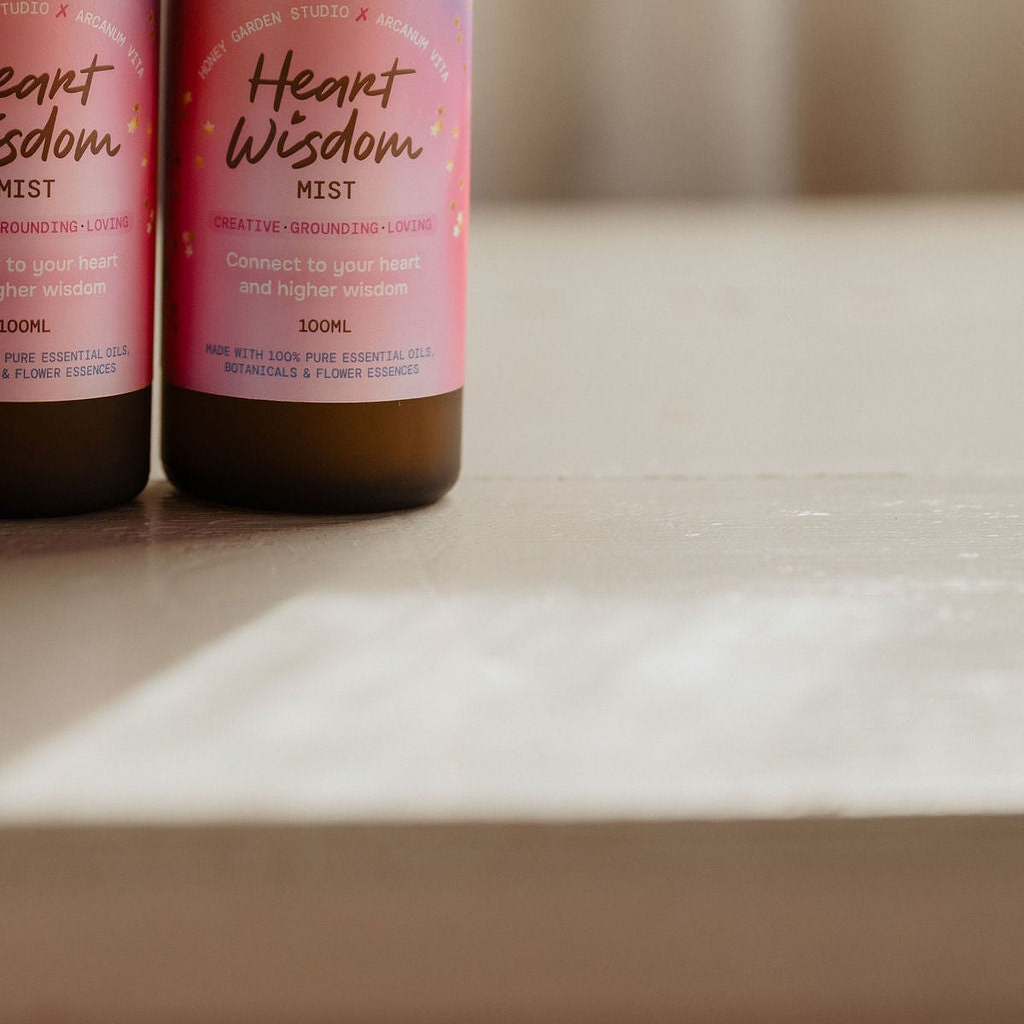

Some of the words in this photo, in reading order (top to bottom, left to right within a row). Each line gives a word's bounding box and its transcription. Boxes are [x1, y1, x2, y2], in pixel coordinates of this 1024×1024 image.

[75, 9, 127, 47] ARCANUM
[127, 44, 145, 79] VITA
[198, 39, 227, 80] HONEY
[231, 11, 282, 43] GARDEN
[290, 4, 350, 20] STUDIO
[376, 13, 430, 50] ARCANUM
[430, 48, 450, 83] VITA
[248, 49, 416, 112] Heart
[226, 108, 423, 170] Wisdom
[297, 180, 356, 200] MIST
[6, 258, 27, 273] to
[32, 258, 74, 277] your
[78, 253, 119, 271] heart
[226, 251, 302, 272] Connect
[306, 258, 327, 273] to
[333, 258, 374, 277] your
[379, 254, 421, 271] heart
[42, 280, 106, 297] wisdom
[239, 279, 272, 296] and
[277, 280, 338, 302] higher
[343, 281, 408, 297] wisdom
[298, 319, 352, 333] 100ML
[4, 351, 36, 364] PURE
[41, 348, 104, 363] ESSENTIAL
[106, 344, 130, 359] OILS,
[205, 343, 231, 358] MADE
[234, 347, 264, 360] WITH
[268, 350, 301, 363] 100%
[305, 351, 337, 364] PURE
[342, 349, 405, 363] ESSENTIAL
[407, 346, 435, 360] OILS,
[1, 368, 10, 380] &
[15, 367, 61, 379] FLOWER
[65, 362, 116, 378] ESSENCES
[224, 361, 298, 378] BOTANICALS
[303, 367, 311, 379] &
[316, 367, 362, 379] FLOWER
[367, 363, 419, 378] ESSENCES
